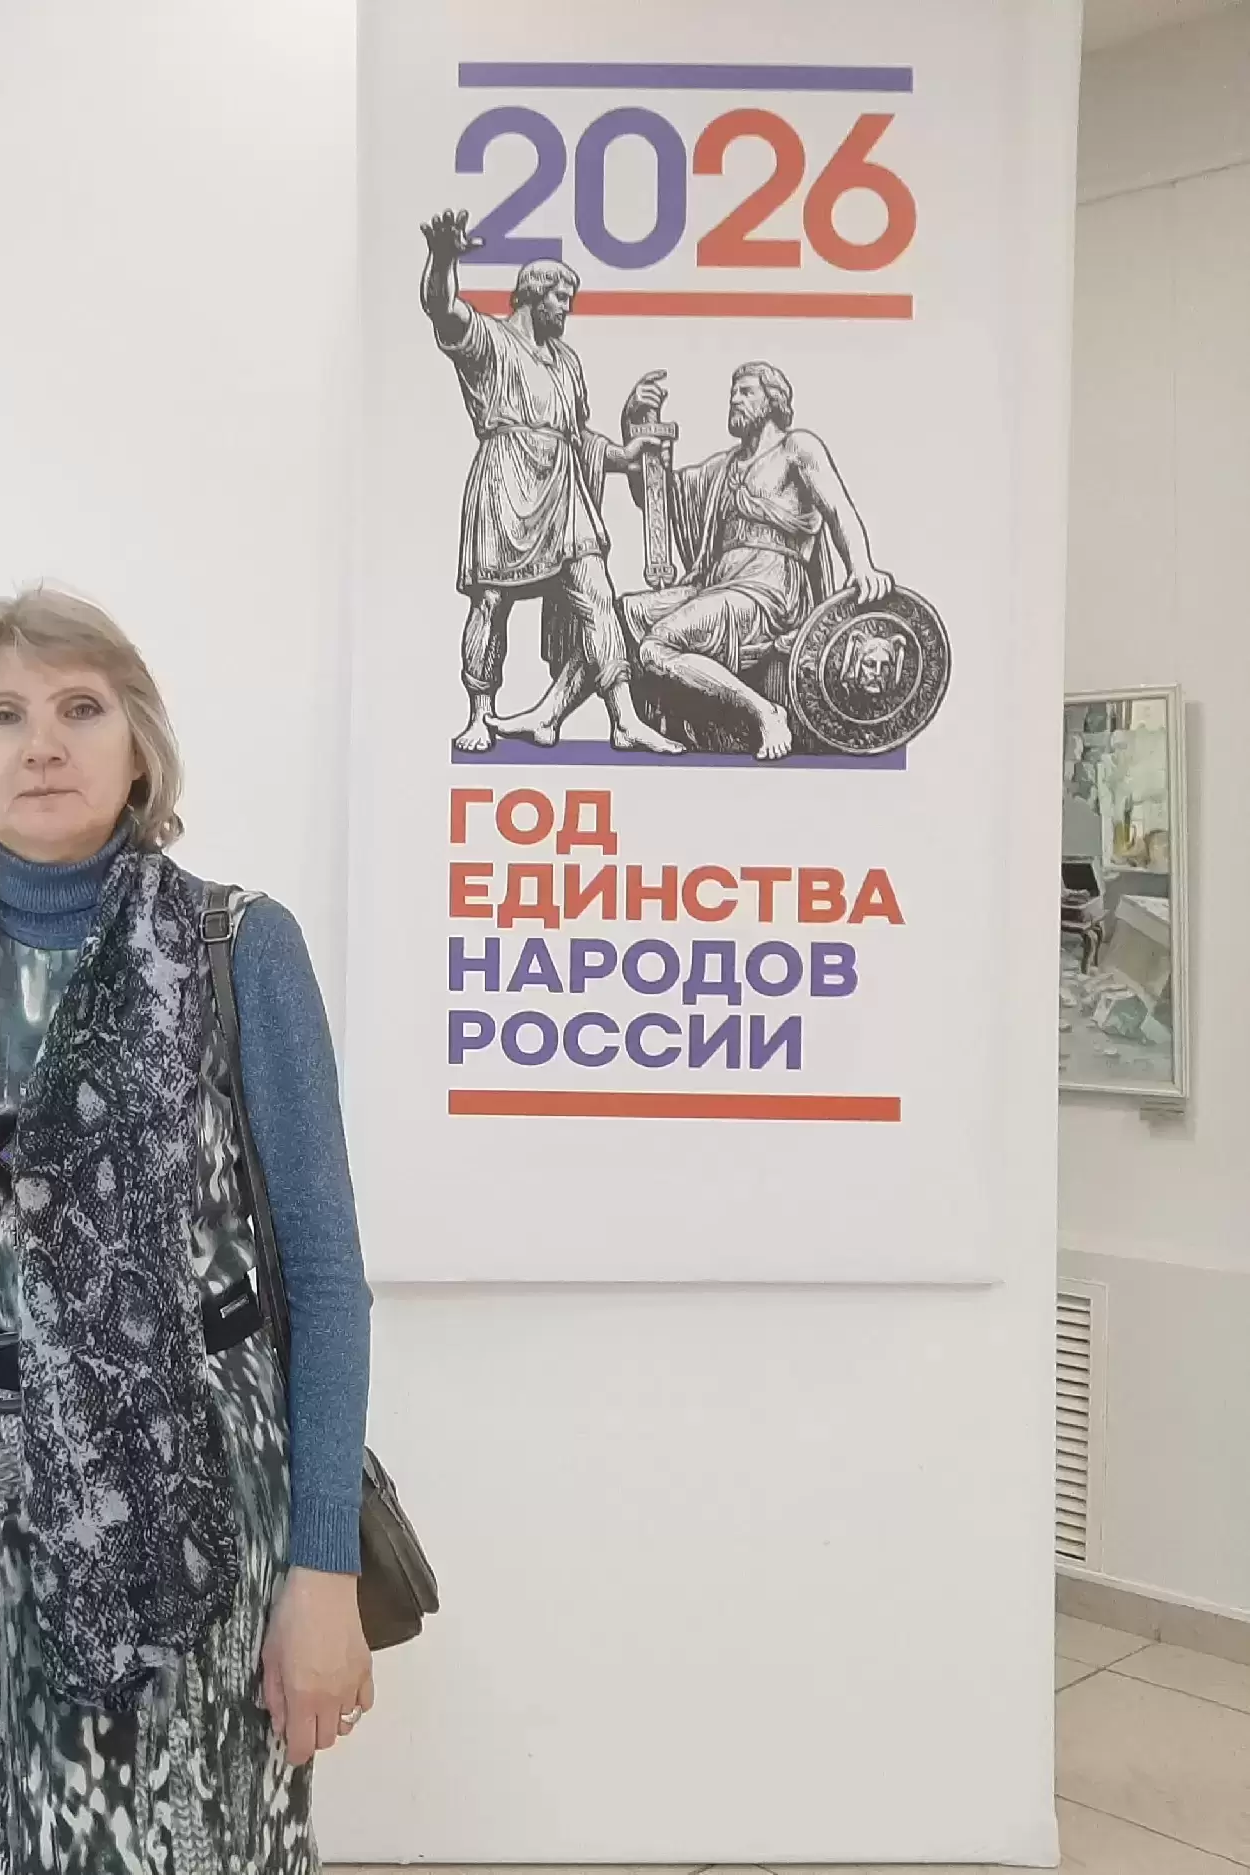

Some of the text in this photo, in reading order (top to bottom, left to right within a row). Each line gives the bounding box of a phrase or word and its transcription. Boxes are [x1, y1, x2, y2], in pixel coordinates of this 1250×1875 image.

[455, 106, 917, 271] 2026
[450, 788, 618, 855] ГОД
[449, 862, 906, 930] ЕДИНСТВА
[449, 936, 858, 1005] НАРОДОВ
[448, 1009, 802, 1070] РОССИИ
